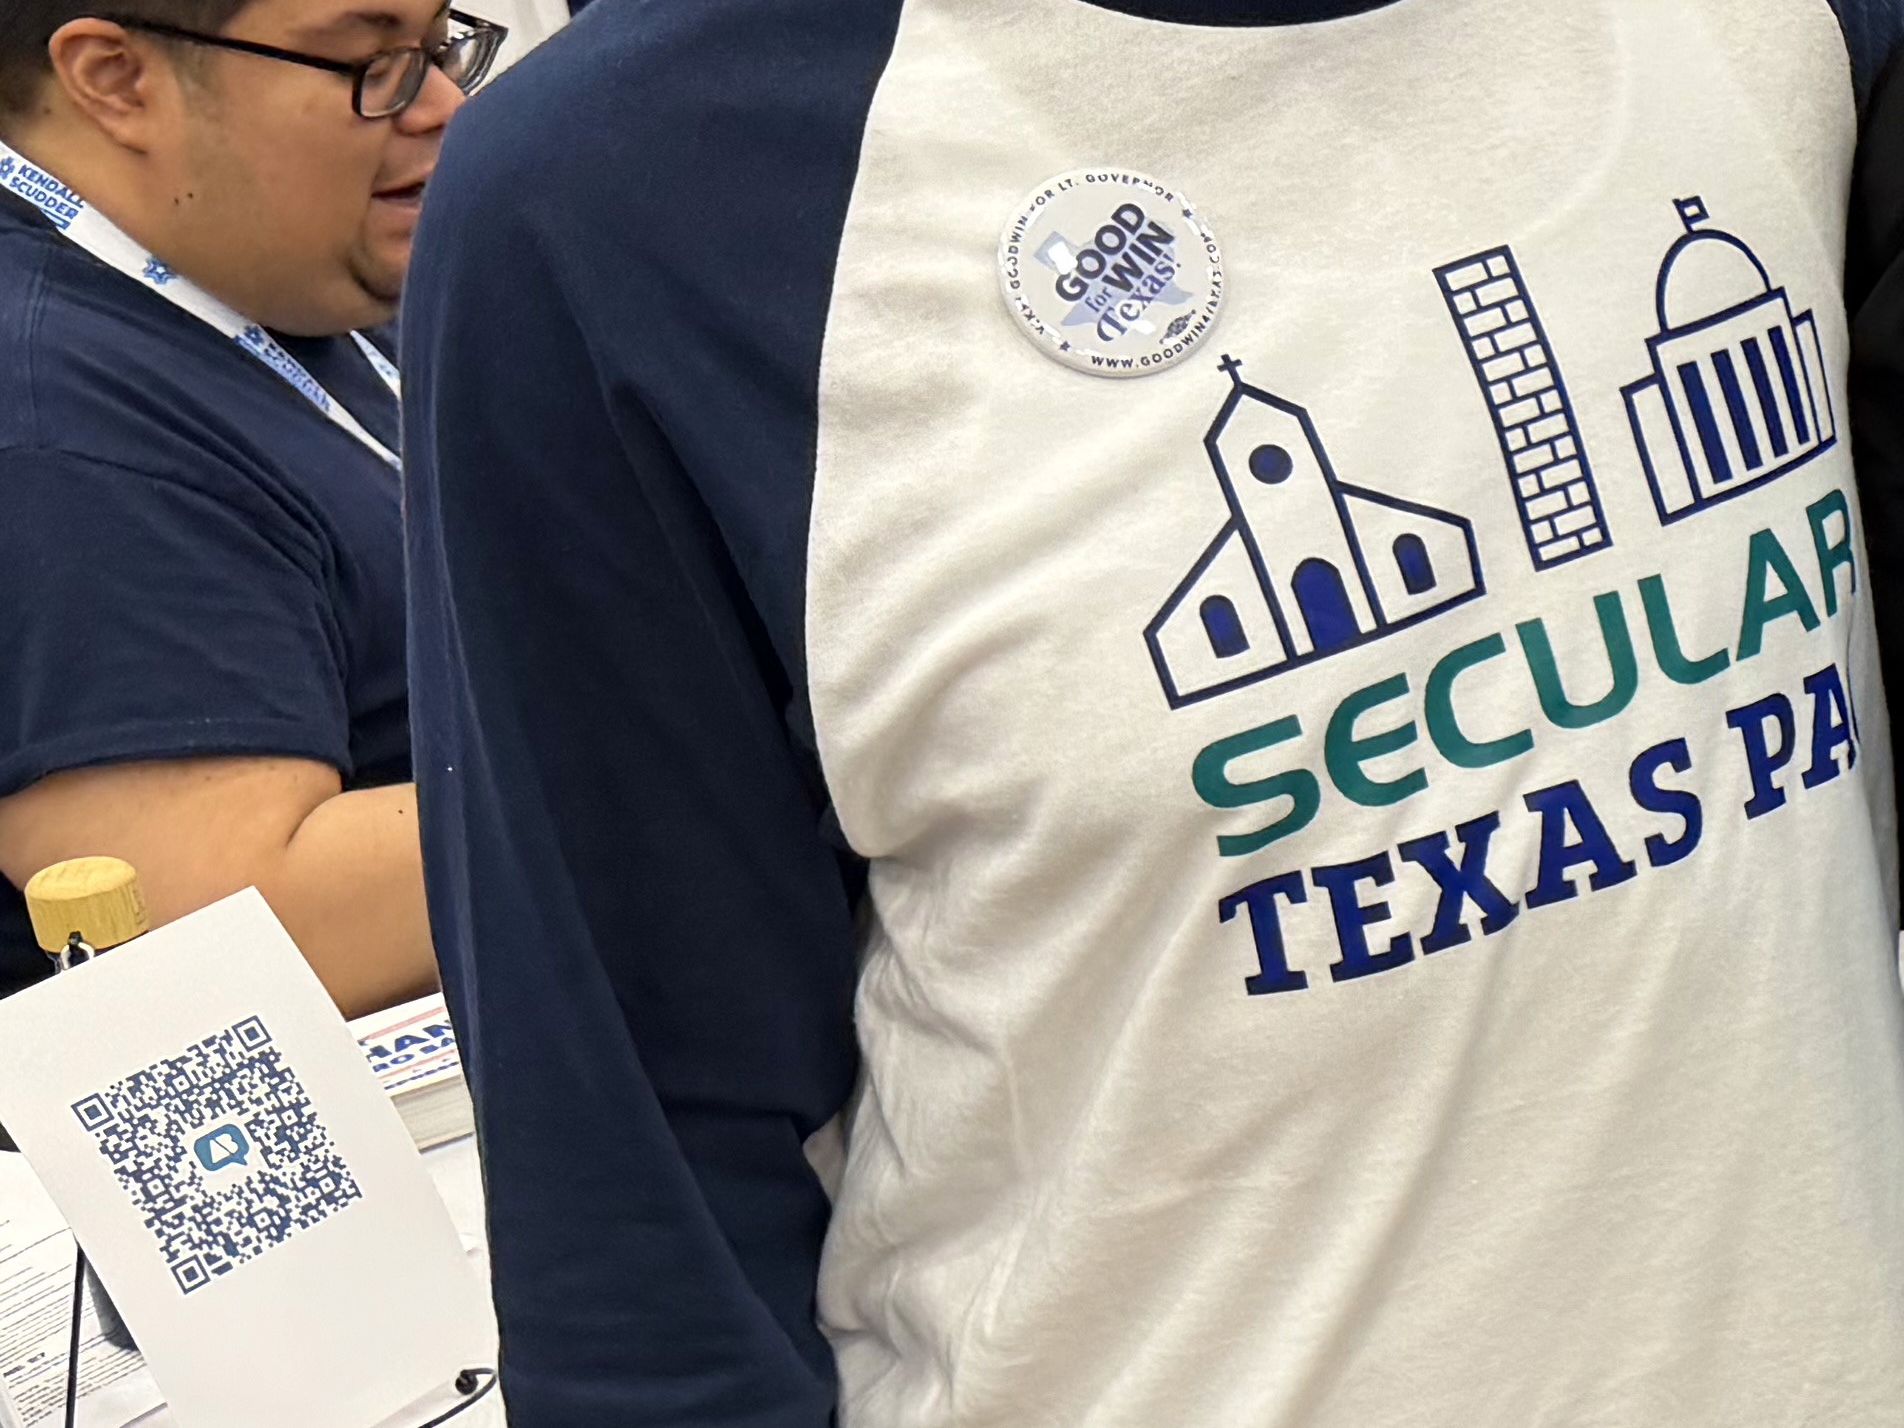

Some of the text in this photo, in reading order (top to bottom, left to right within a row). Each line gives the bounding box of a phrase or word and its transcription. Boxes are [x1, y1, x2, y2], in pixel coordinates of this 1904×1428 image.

[9, 177, 79, 219] SCUDDER
[18, 164, 83, 208] KENDALL
[1055, 203, 1145, 302] GOOD
[1102, 221, 1175, 292] WIN
[1085, 287, 1113, 312] for
[1096, 253, 1181, 341] Texas!
[1191, 488, 1858, 857] SECULAR
[1217, 737, 1706, 996] TEXAS
